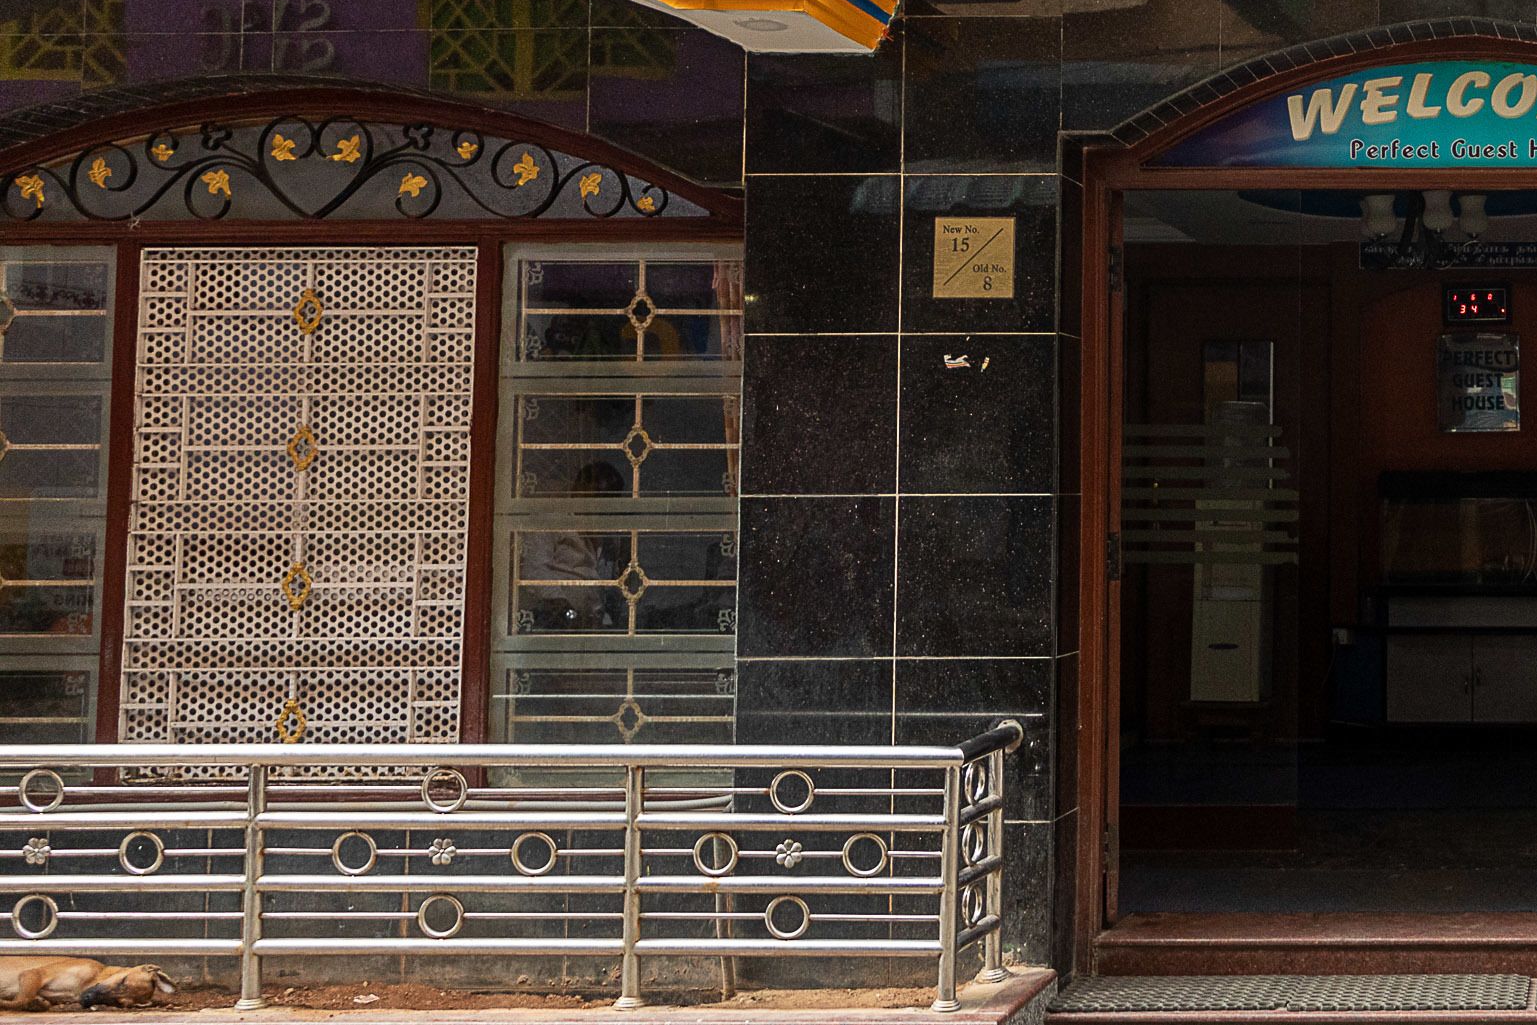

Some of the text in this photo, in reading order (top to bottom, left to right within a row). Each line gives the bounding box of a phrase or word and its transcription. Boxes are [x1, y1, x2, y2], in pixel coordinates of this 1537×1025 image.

[1348, 138, 1441, 161] Perfect
[1450, 138, 1518, 161] Guest
[943, 224, 980, 234] New No.
[951, 237, 970, 252] 15
[972, 263, 1007, 273] Old No.
[983, 276, 992, 291] 8
[1440, 350, 1513, 366] PERFECT
[1452, 374, 1503, 389] GUEST
[1452, 396, 1505, 411] HOUSE
